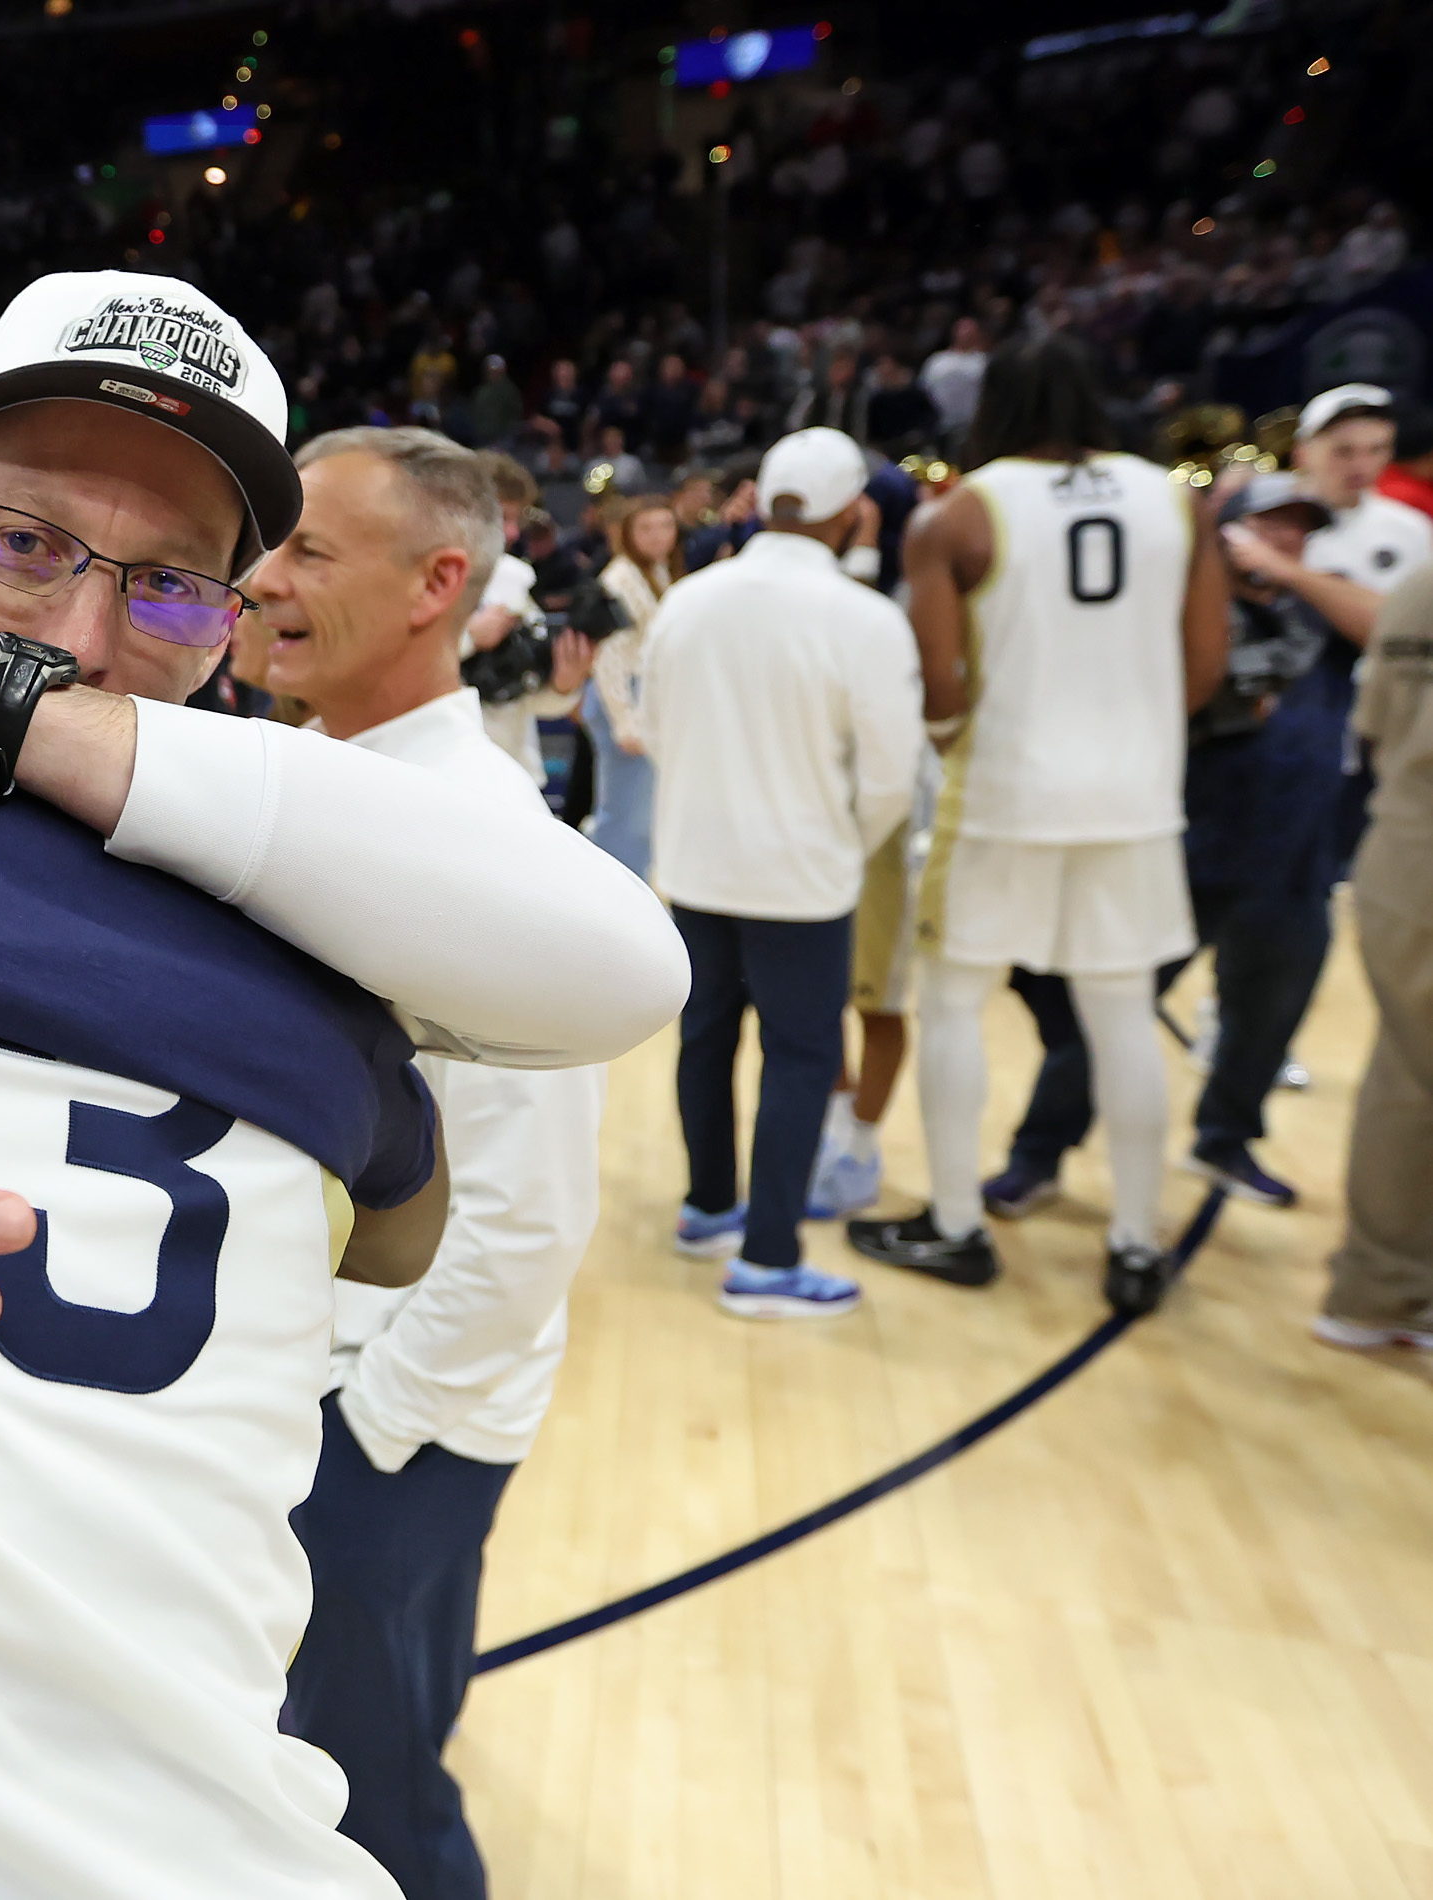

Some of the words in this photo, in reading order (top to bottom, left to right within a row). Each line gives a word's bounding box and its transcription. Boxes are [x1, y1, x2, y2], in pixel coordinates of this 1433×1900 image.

[101, 297, 147, 315] Men's
[150, 298, 223, 335] Basketball
[66, 314, 241, 388] CHAMPIONS
[181, 366, 222, 394] 2026
[1069, 517, 1124, 602] 0
